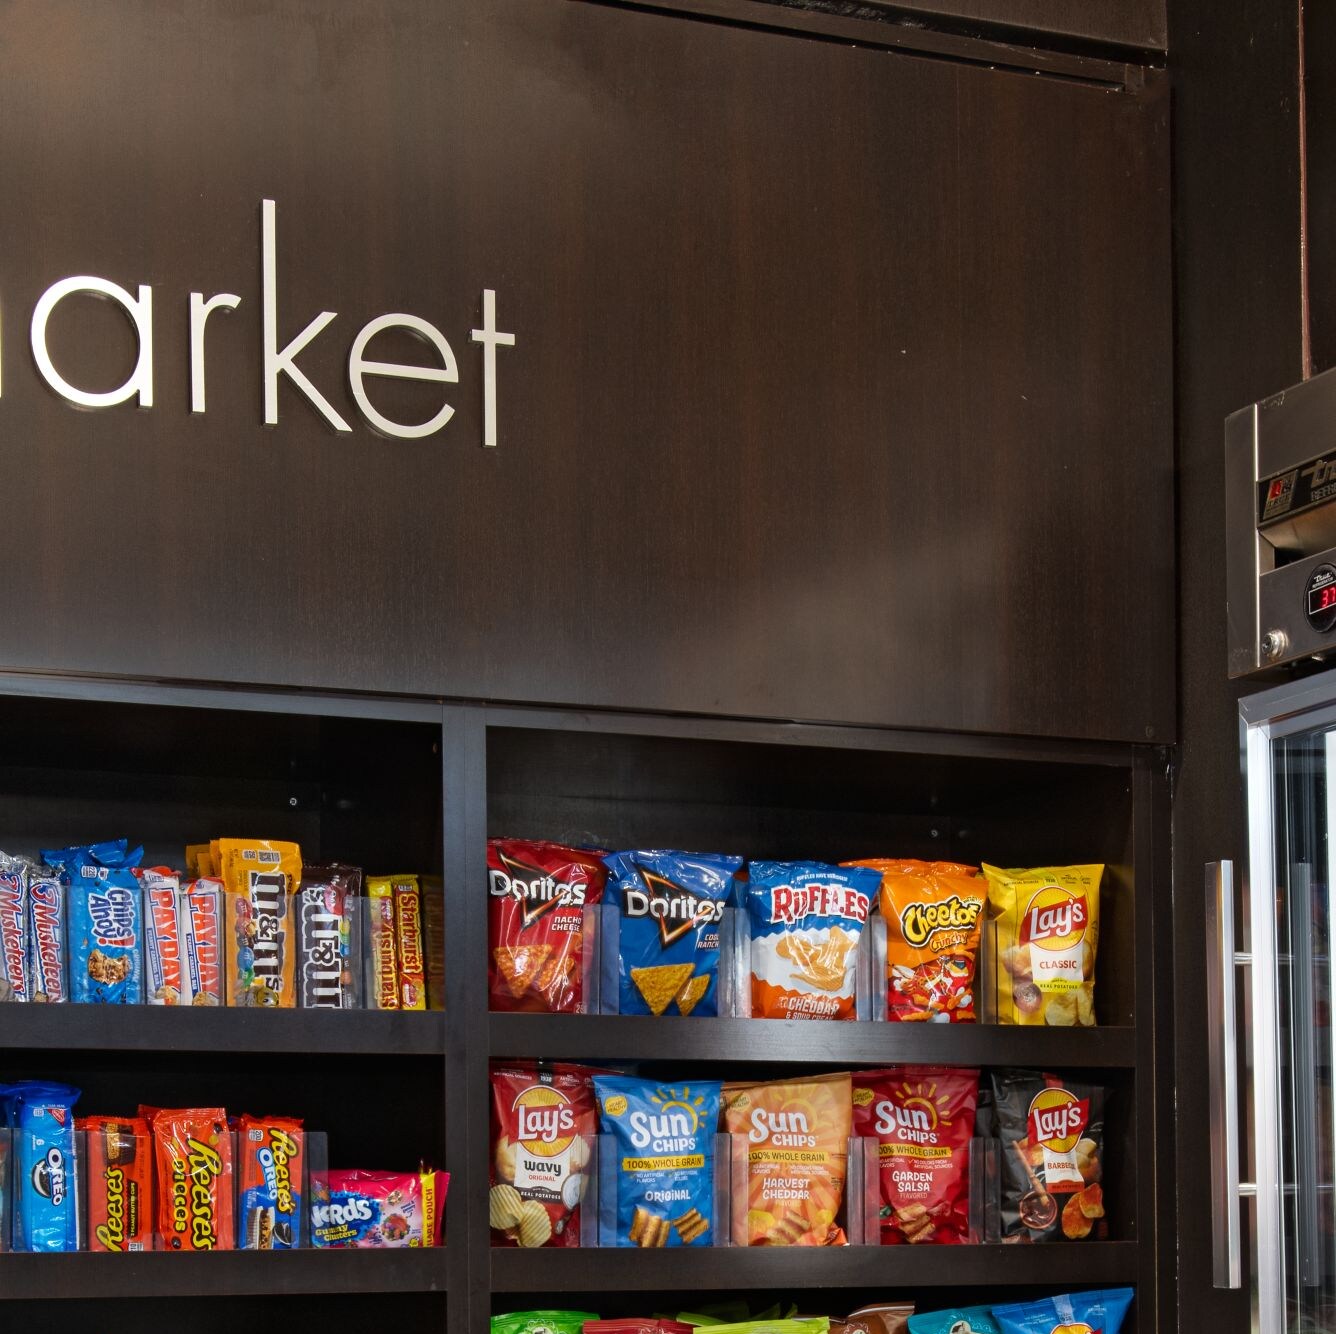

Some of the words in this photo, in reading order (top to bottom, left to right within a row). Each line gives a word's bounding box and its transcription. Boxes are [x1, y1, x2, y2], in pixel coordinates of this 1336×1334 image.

[0, 199, 516, 447] arket
[489, 869, 588, 905] Doritos
[107, 888, 135, 940] Chips
[553, 915, 582, 925] NACHO
[627, 891, 725, 922] Doritos
[903, 897, 982, 945] Cheetos
[1029, 897, 1085, 941] Lay's
[150, 888, 181, 993] PAYDAY
[400, 894, 421, 973] Starburst
[551, 923, 580, 932] CHEESE
[190, 894, 222, 998] PAYDAY
[1039, 960, 1077, 970] CLASSIC
[788, 996, 840, 1016] CHEDDAR
[518, 1103, 574, 1143] Lay's
[629, 1111, 691, 1149] Sun
[748, 1107, 810, 1143] Sun
[875, 1100, 930, 1135] Sun
[1033, 1101, 1082, 1142] Lay's
[652, 1137, 697, 1153] CHIPS
[771, 1133, 816, 1148] CHIPS
[896, 1145, 922, 1156] WHOLE
[922, 1149, 948, 1157] GRAIN
[897, 1127, 939, 1144] CHIPS
[269, 1127, 298, 1214] Reese's
[524, 1159, 562, 1176] wavy
[626, 1159, 652, 1169] 100%
[653, 1159, 680, 1168] WHOLE
[681, 1157, 702, 1167] GRAIN
[771, 1151, 799, 1161] WHOLE
[800, 1152, 825, 1162] GRAIN
[47, 1148, 64, 1206] OREO
[257, 1147, 278, 1200] OREO
[528, 1174, 556, 1182] ORIGINAL
[762, 1177, 811, 1190] HARVEST
[892, 1170, 933, 1182] GARDEN
[897, 1181, 931, 1193] SALSA
[97, 1166, 124, 1251] Reese's
[187, 1137, 223, 1250] Reese's
[425, 1188, 434, 1220] POUCH
[762, 1189, 811, 1200] CHEDDAR
